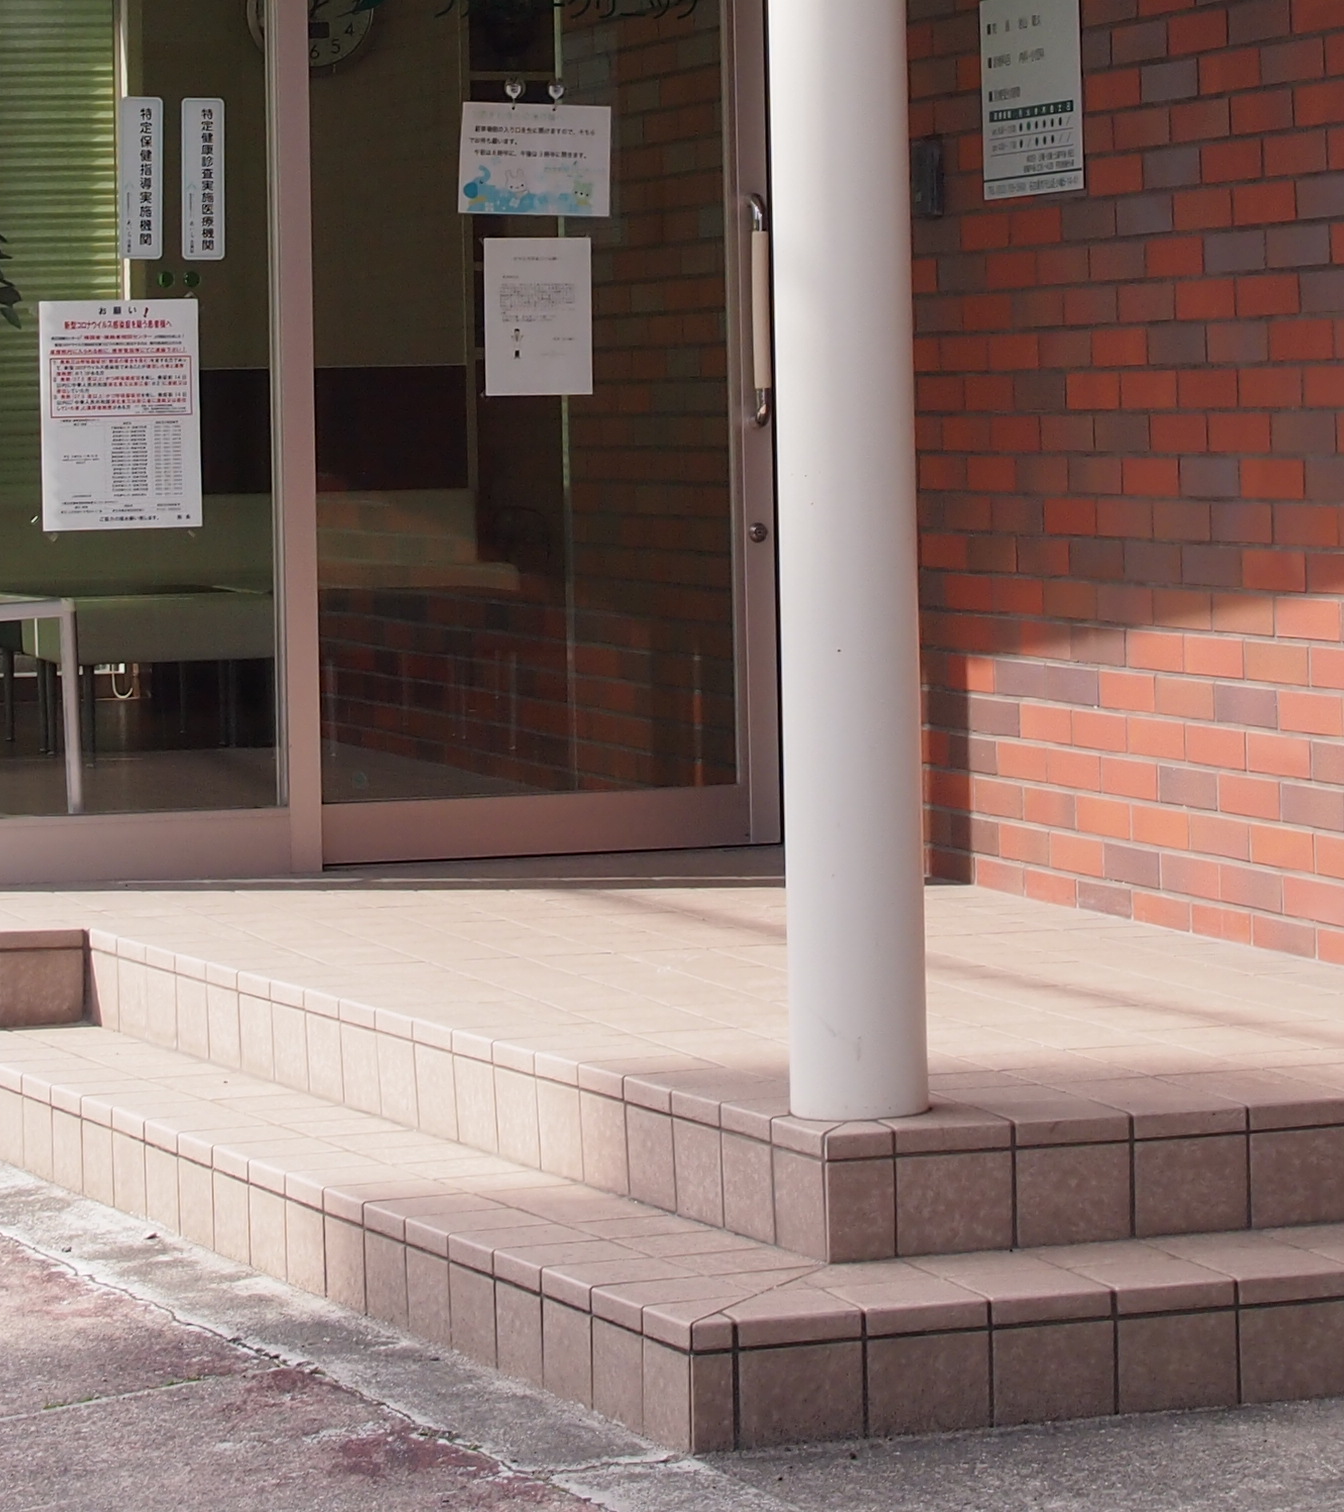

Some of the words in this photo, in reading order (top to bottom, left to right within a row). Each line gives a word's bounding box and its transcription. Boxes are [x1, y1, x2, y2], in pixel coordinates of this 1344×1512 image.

[139, 108, 152, 246] 特定保健指導実施機関
[201, 108, 214, 251] 特定健康診査実施医療機関
